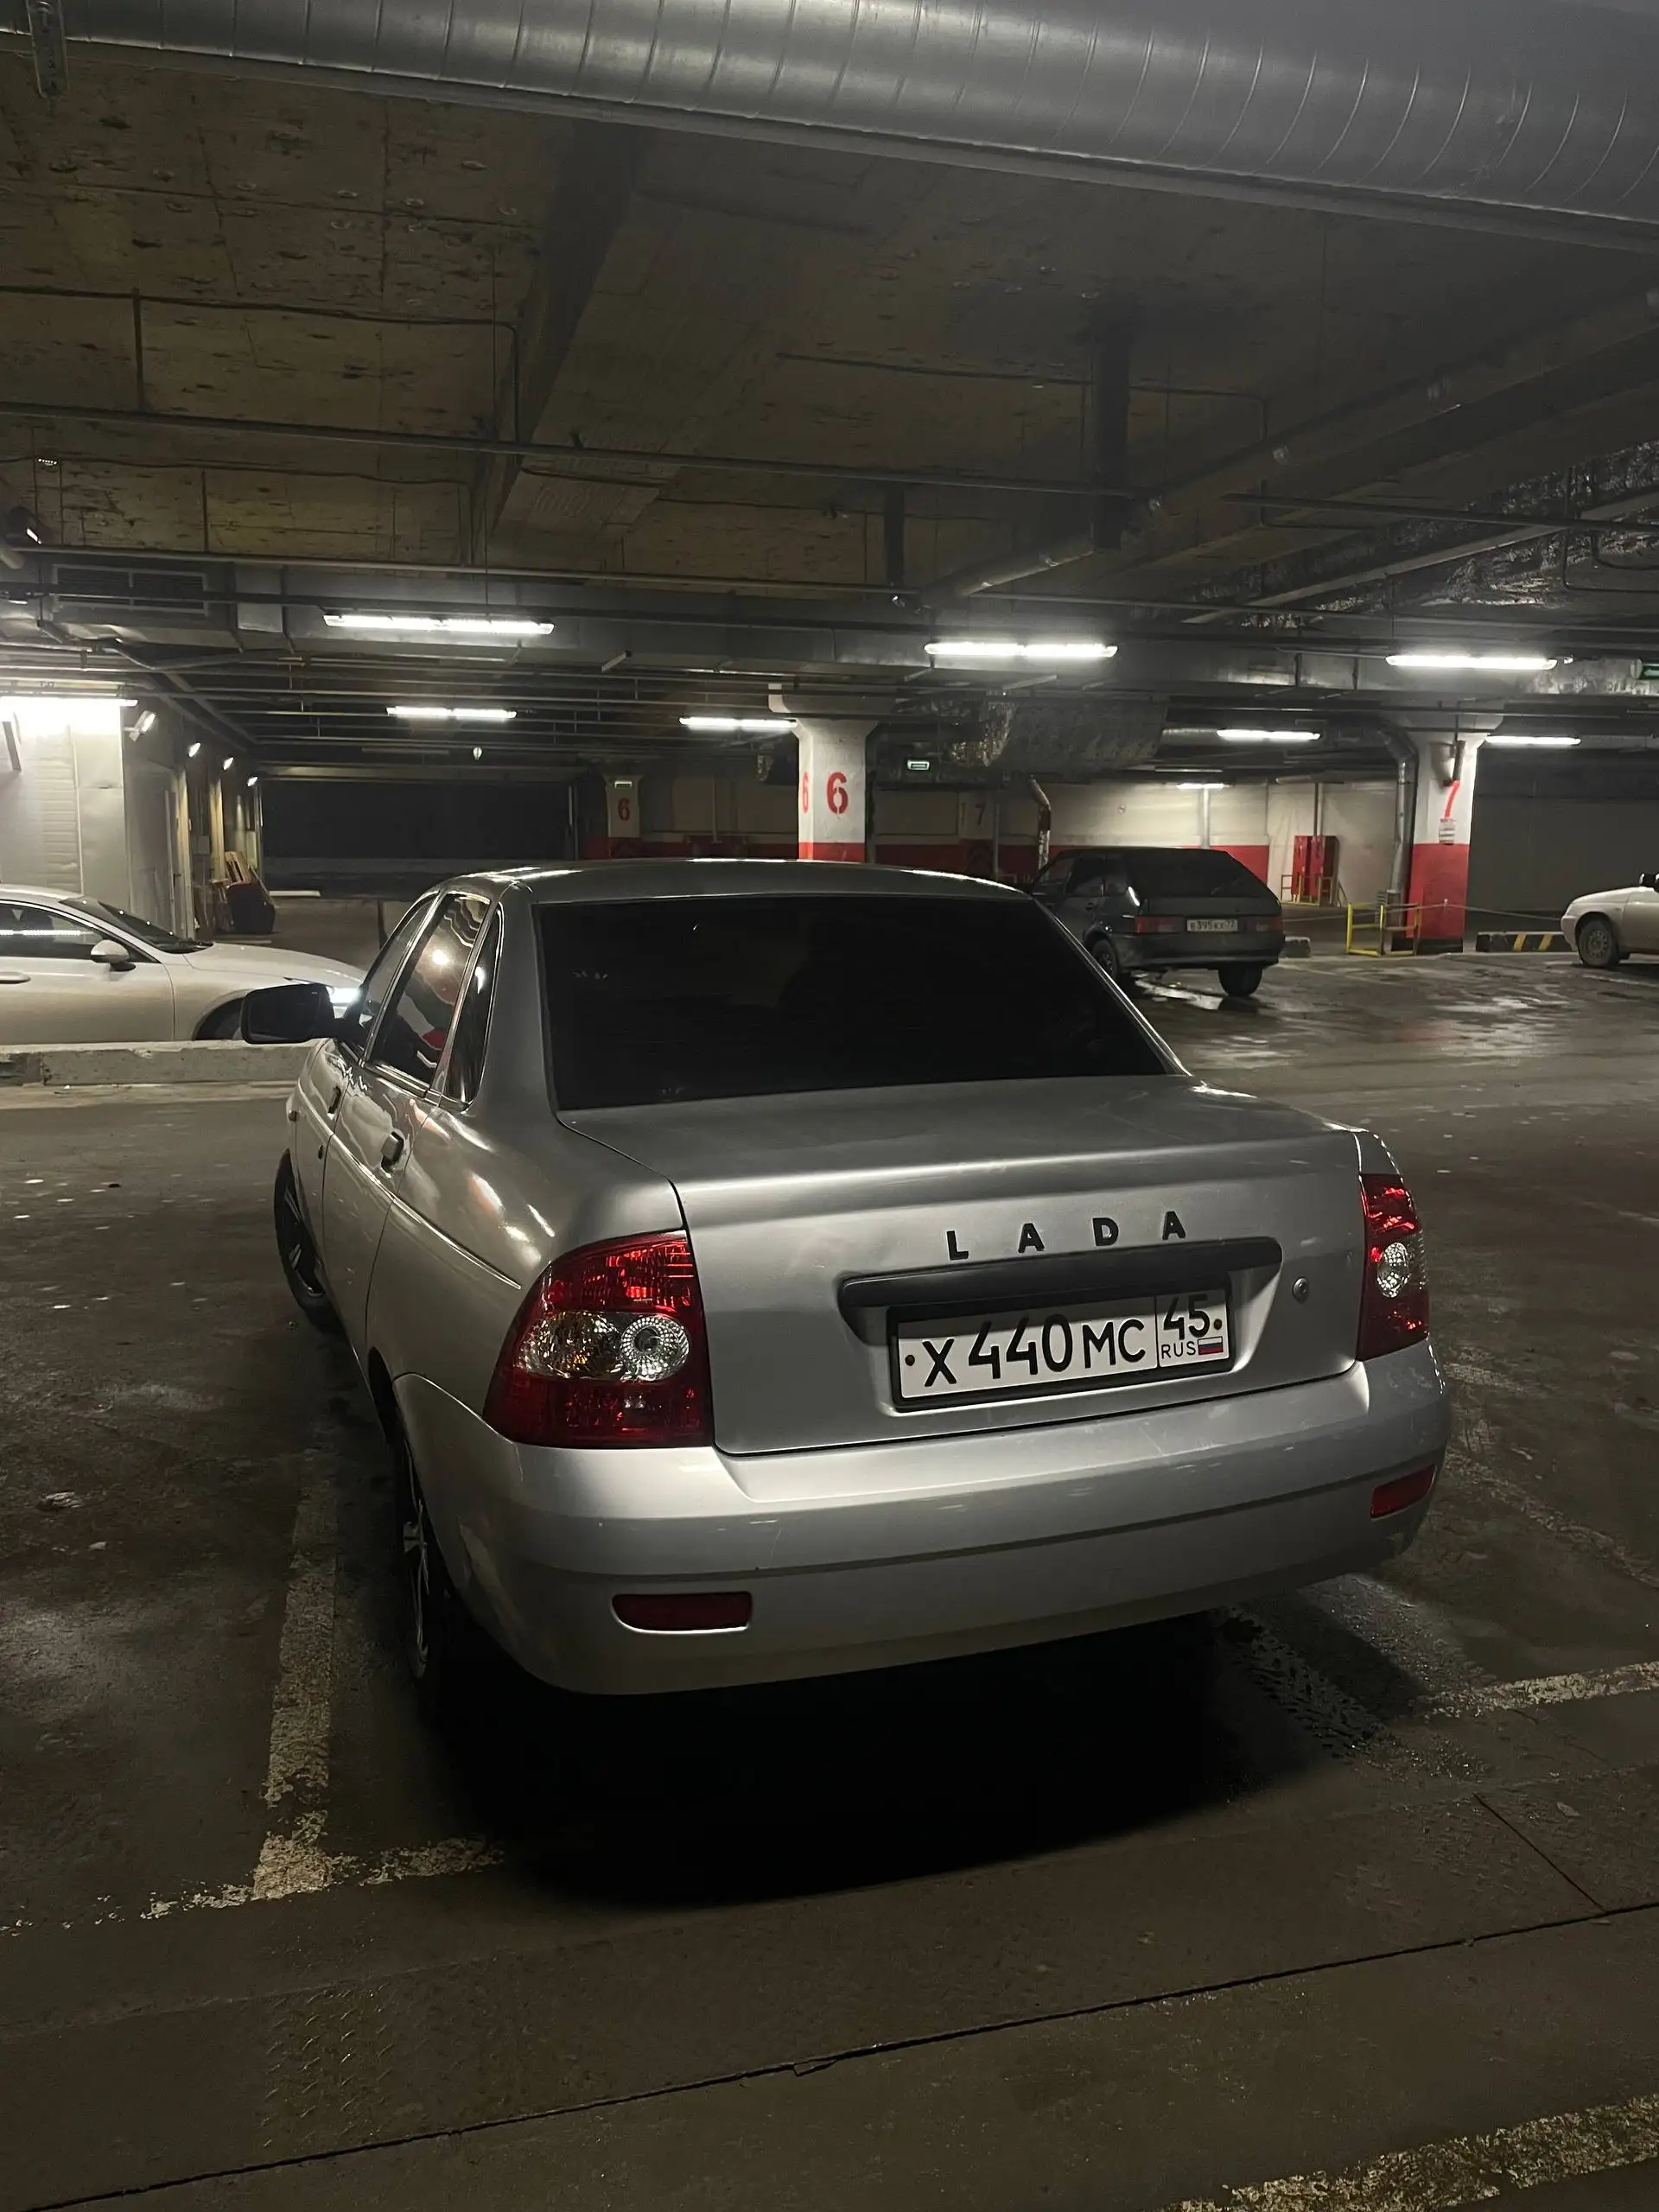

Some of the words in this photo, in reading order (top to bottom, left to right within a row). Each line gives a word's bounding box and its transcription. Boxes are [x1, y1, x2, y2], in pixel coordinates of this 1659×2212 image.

[618, 798, 630, 821] 6
[802, 772, 809, 814] 6
[827, 772, 849, 816] 6
[946, 1211, 1186, 1261] LADA
[922, 1313, 1147, 1388] Х440МС
[1163, 1294, 1211, 1340] 45
[1160, 1340, 1197, 1359] RUS
